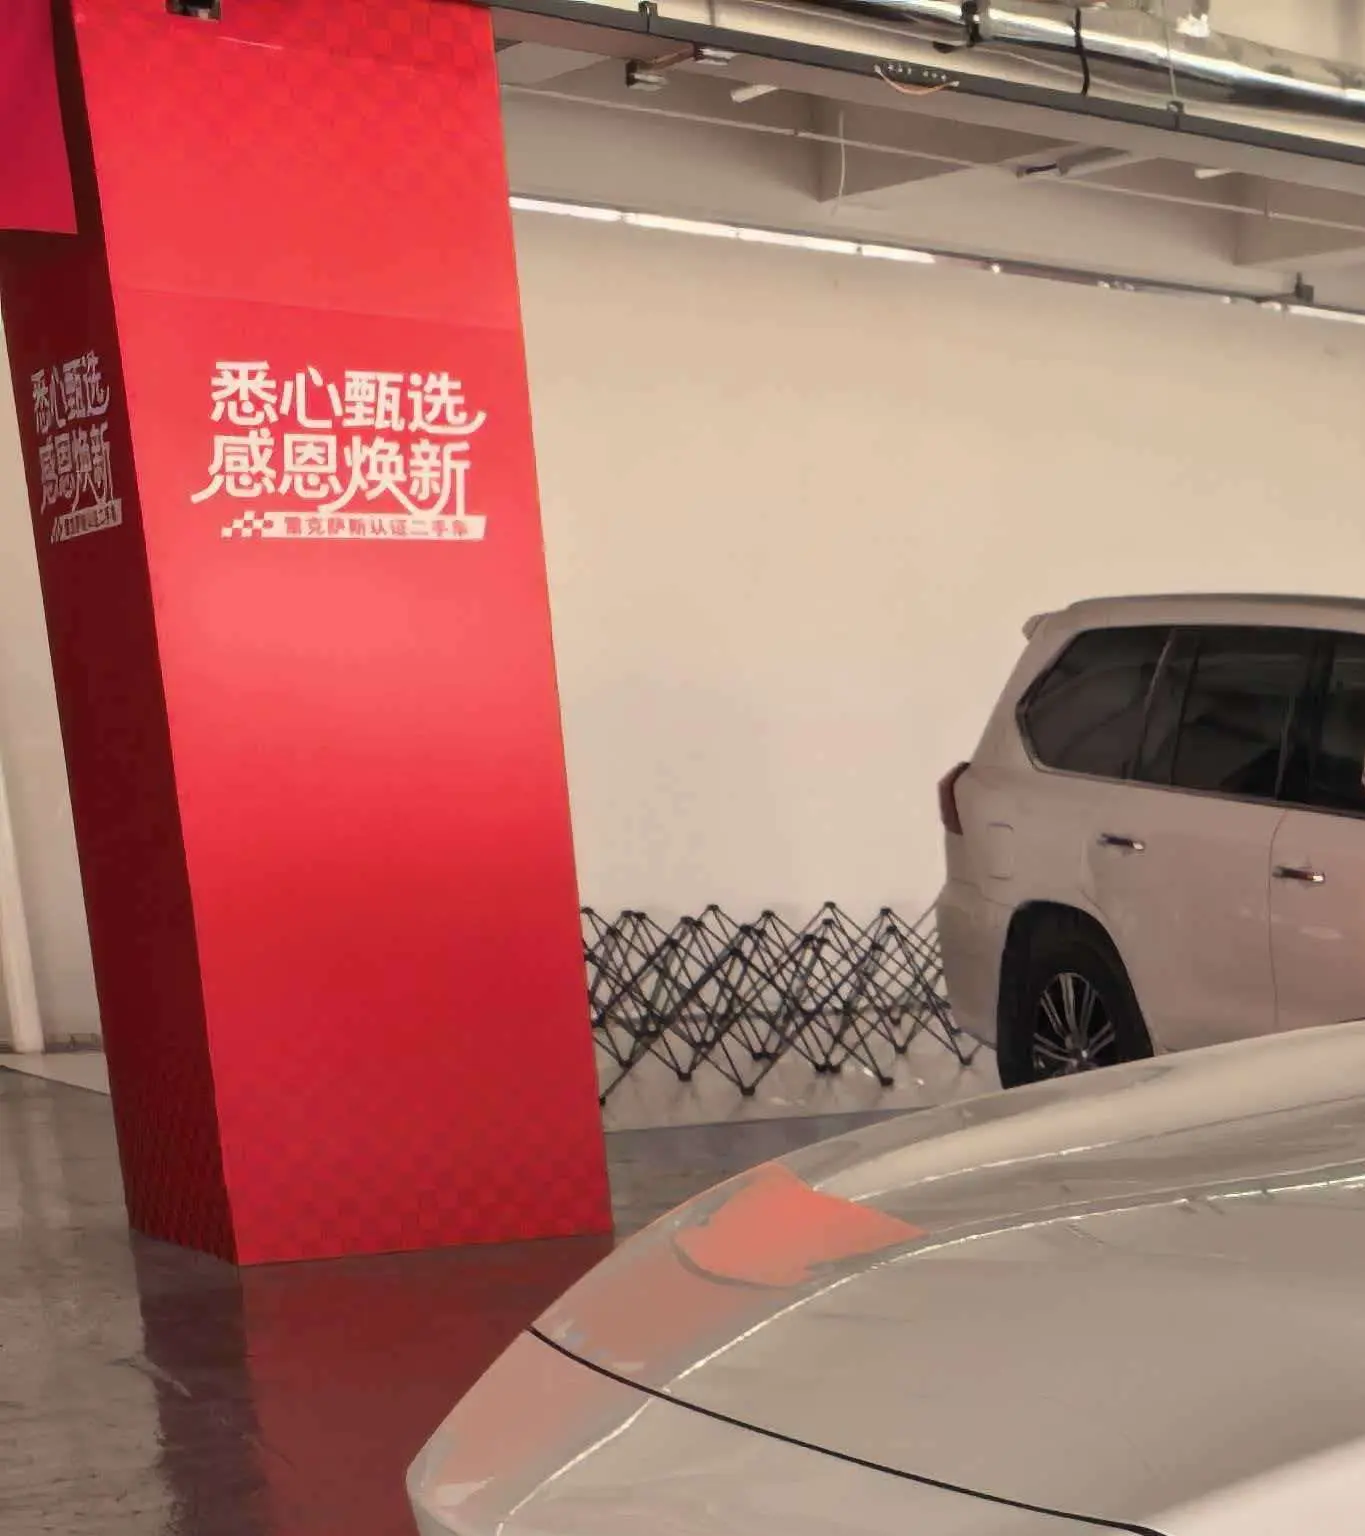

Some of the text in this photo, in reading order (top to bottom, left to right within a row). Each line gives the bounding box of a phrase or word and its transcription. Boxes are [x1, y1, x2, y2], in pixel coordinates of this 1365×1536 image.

[209, 360, 487, 435] 悉心甄选
[190, 427, 471, 518] 感恩焕新
